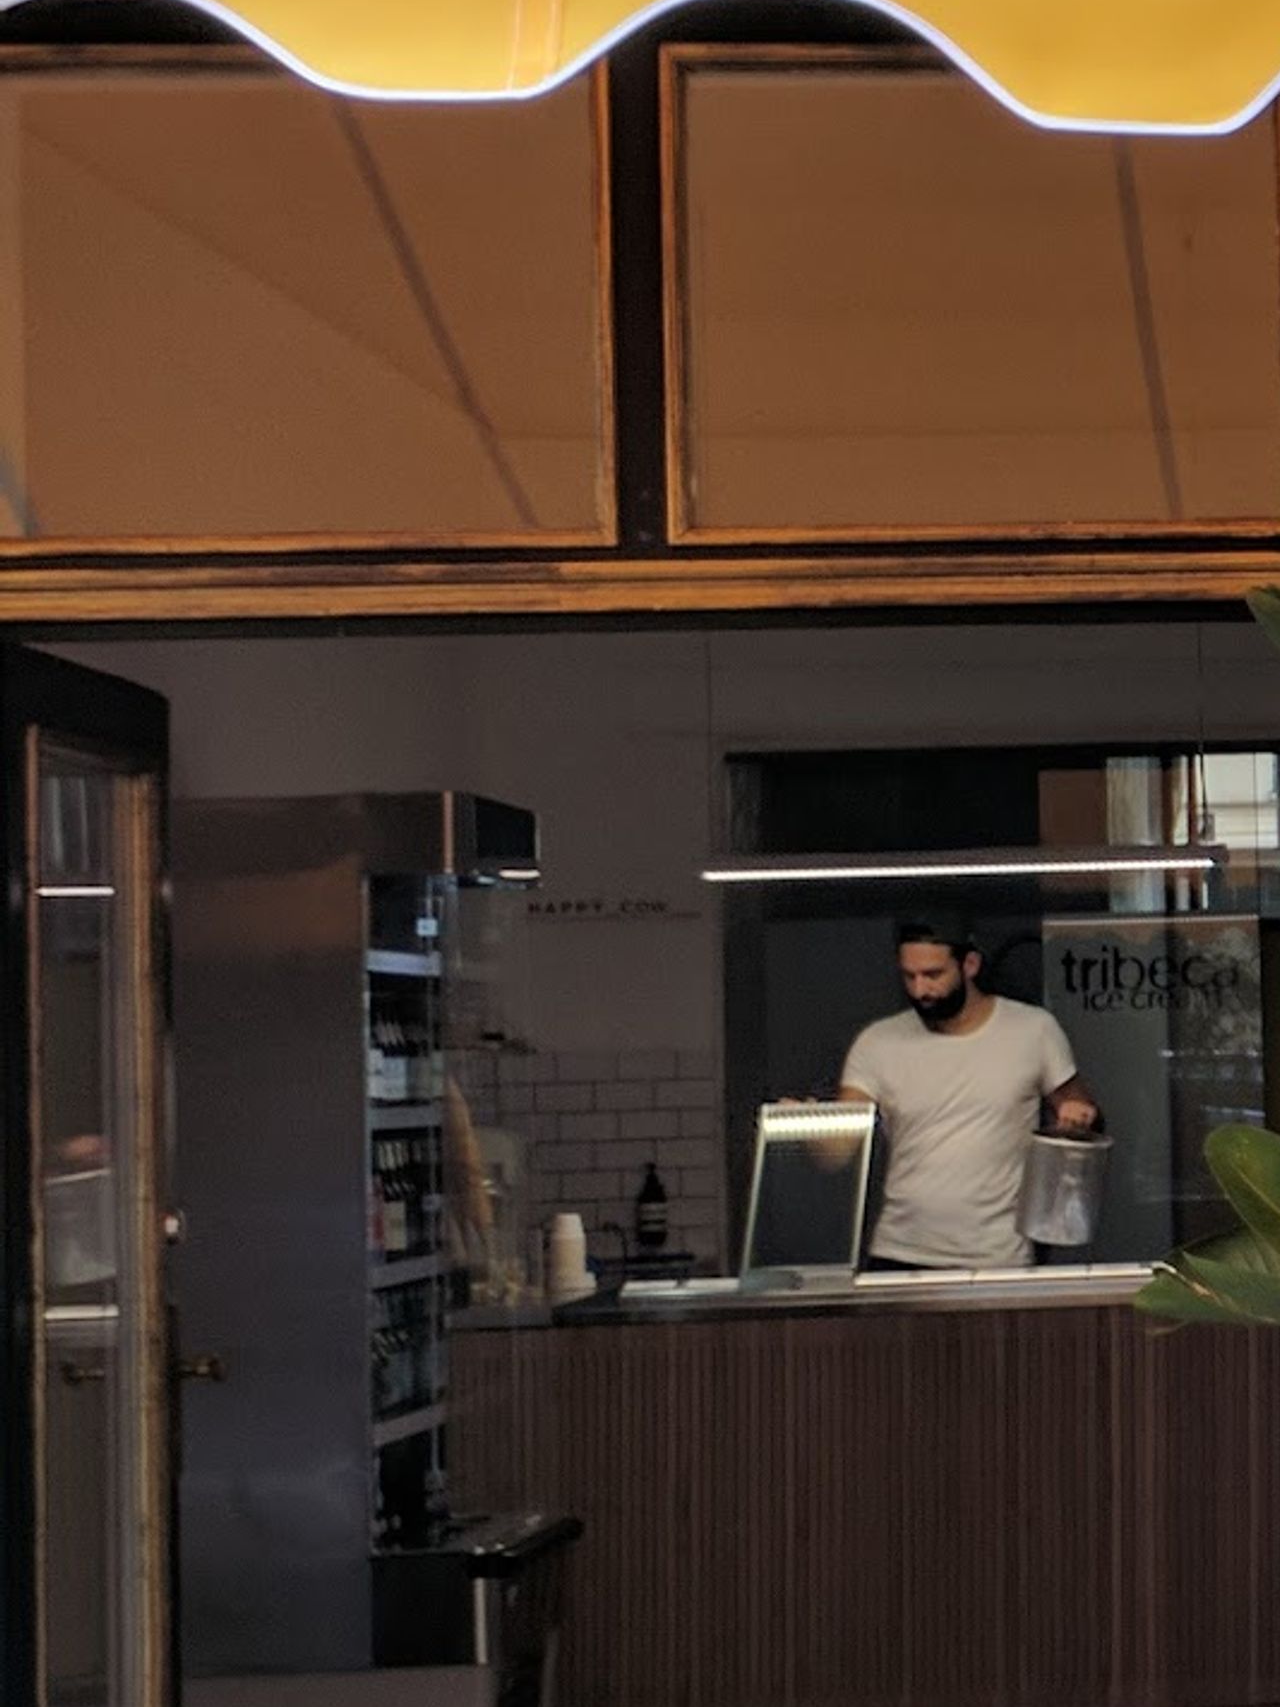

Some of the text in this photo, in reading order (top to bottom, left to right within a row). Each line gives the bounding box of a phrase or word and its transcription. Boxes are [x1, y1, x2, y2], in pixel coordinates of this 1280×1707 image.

[528, 901, 602, 914] HAPPY
[1061, 945, 1239, 993] tribeca
[1083, 991, 1226, 1011] ice cre
